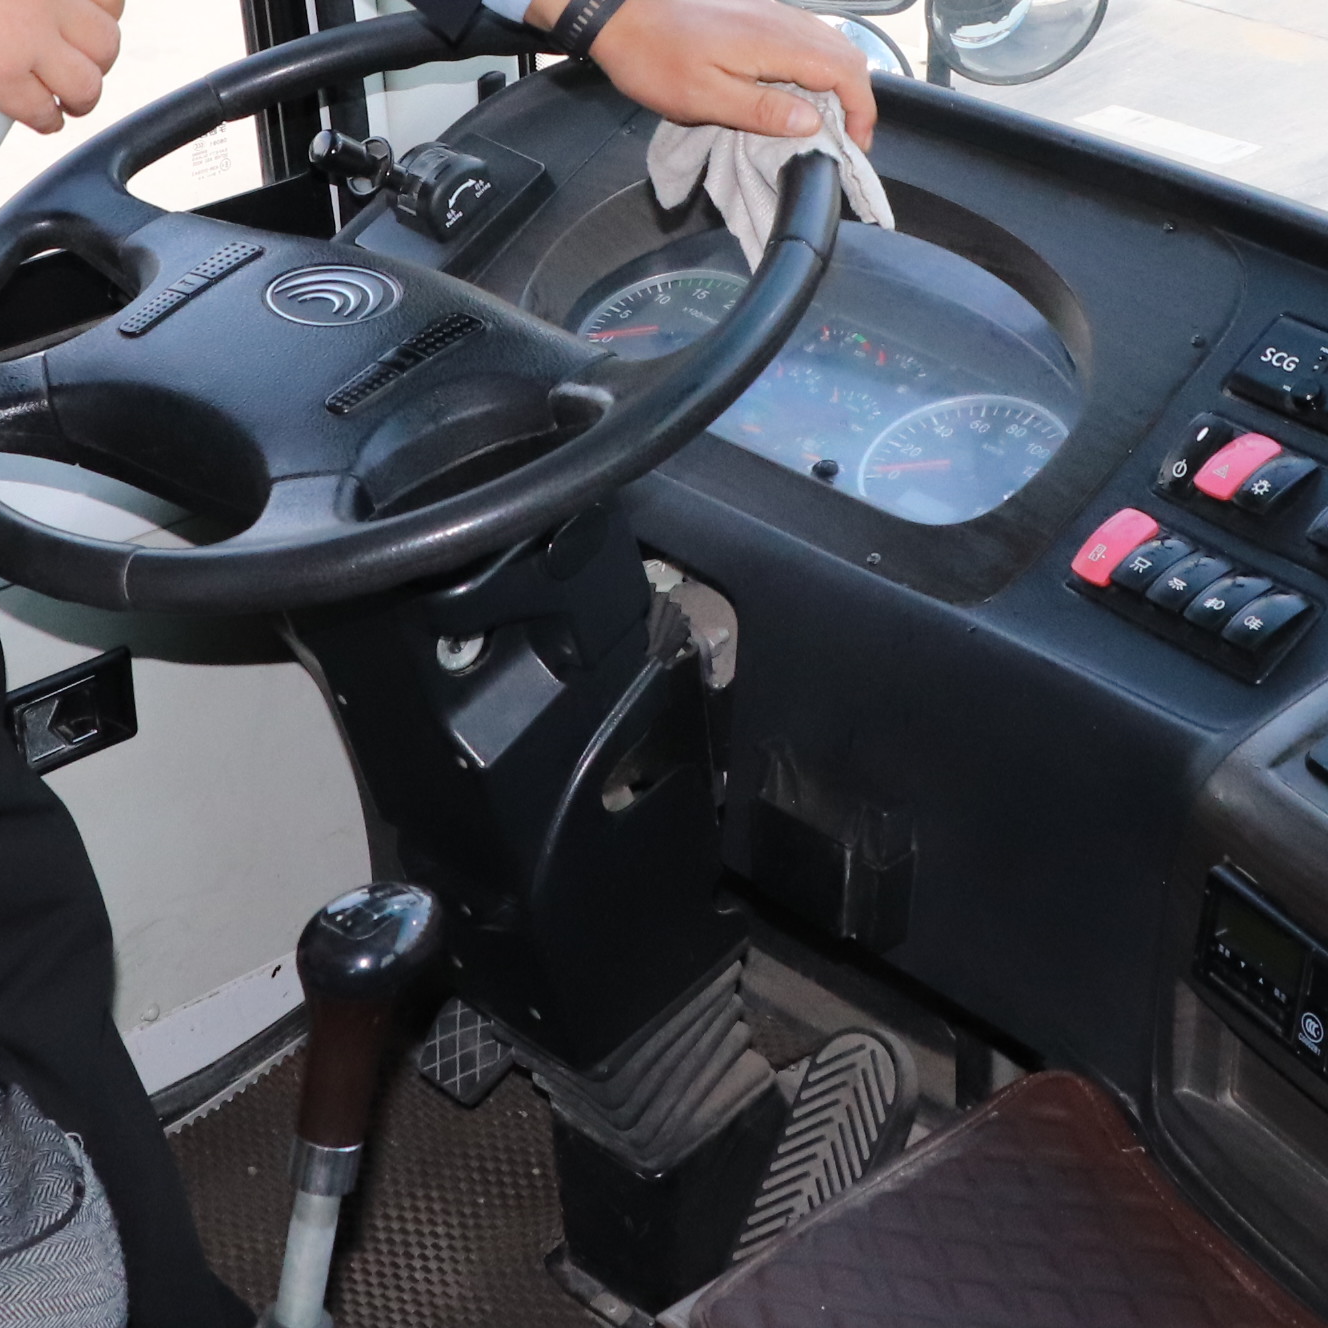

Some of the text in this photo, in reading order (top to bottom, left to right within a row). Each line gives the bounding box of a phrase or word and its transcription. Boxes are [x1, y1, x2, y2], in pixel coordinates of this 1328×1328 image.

[654, 293, 671, 305] 10
[691, 288, 710, 300] 15
[619, 309, 632, 319] 5
[1260, 347, 1300, 372] SCG
[933, 423, 954, 438] 40
[970, 420, 990, 433] 60
[1005, 423, 1027, 438] 80
[900, 443, 922, 457] 20
[1025, 442, 1051, 459] 100
[888, 470, 900, 480] 0
